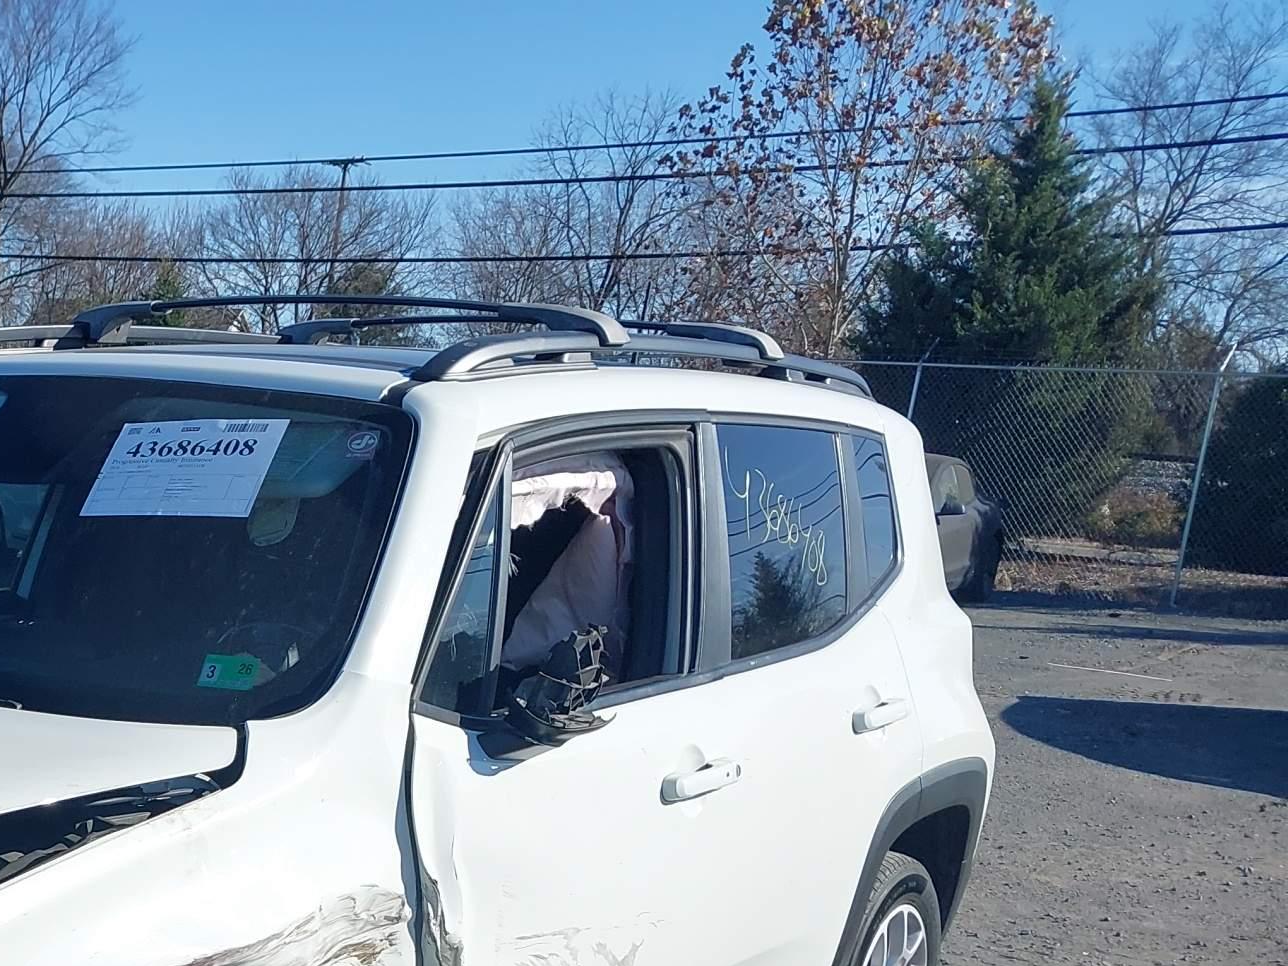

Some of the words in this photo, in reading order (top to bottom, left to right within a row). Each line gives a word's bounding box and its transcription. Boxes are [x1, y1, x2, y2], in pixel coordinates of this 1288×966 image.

[126, 438, 258, 458] 43686408
[206, 664, 217, 679] 3
[238, 663, 254, 675] 26
